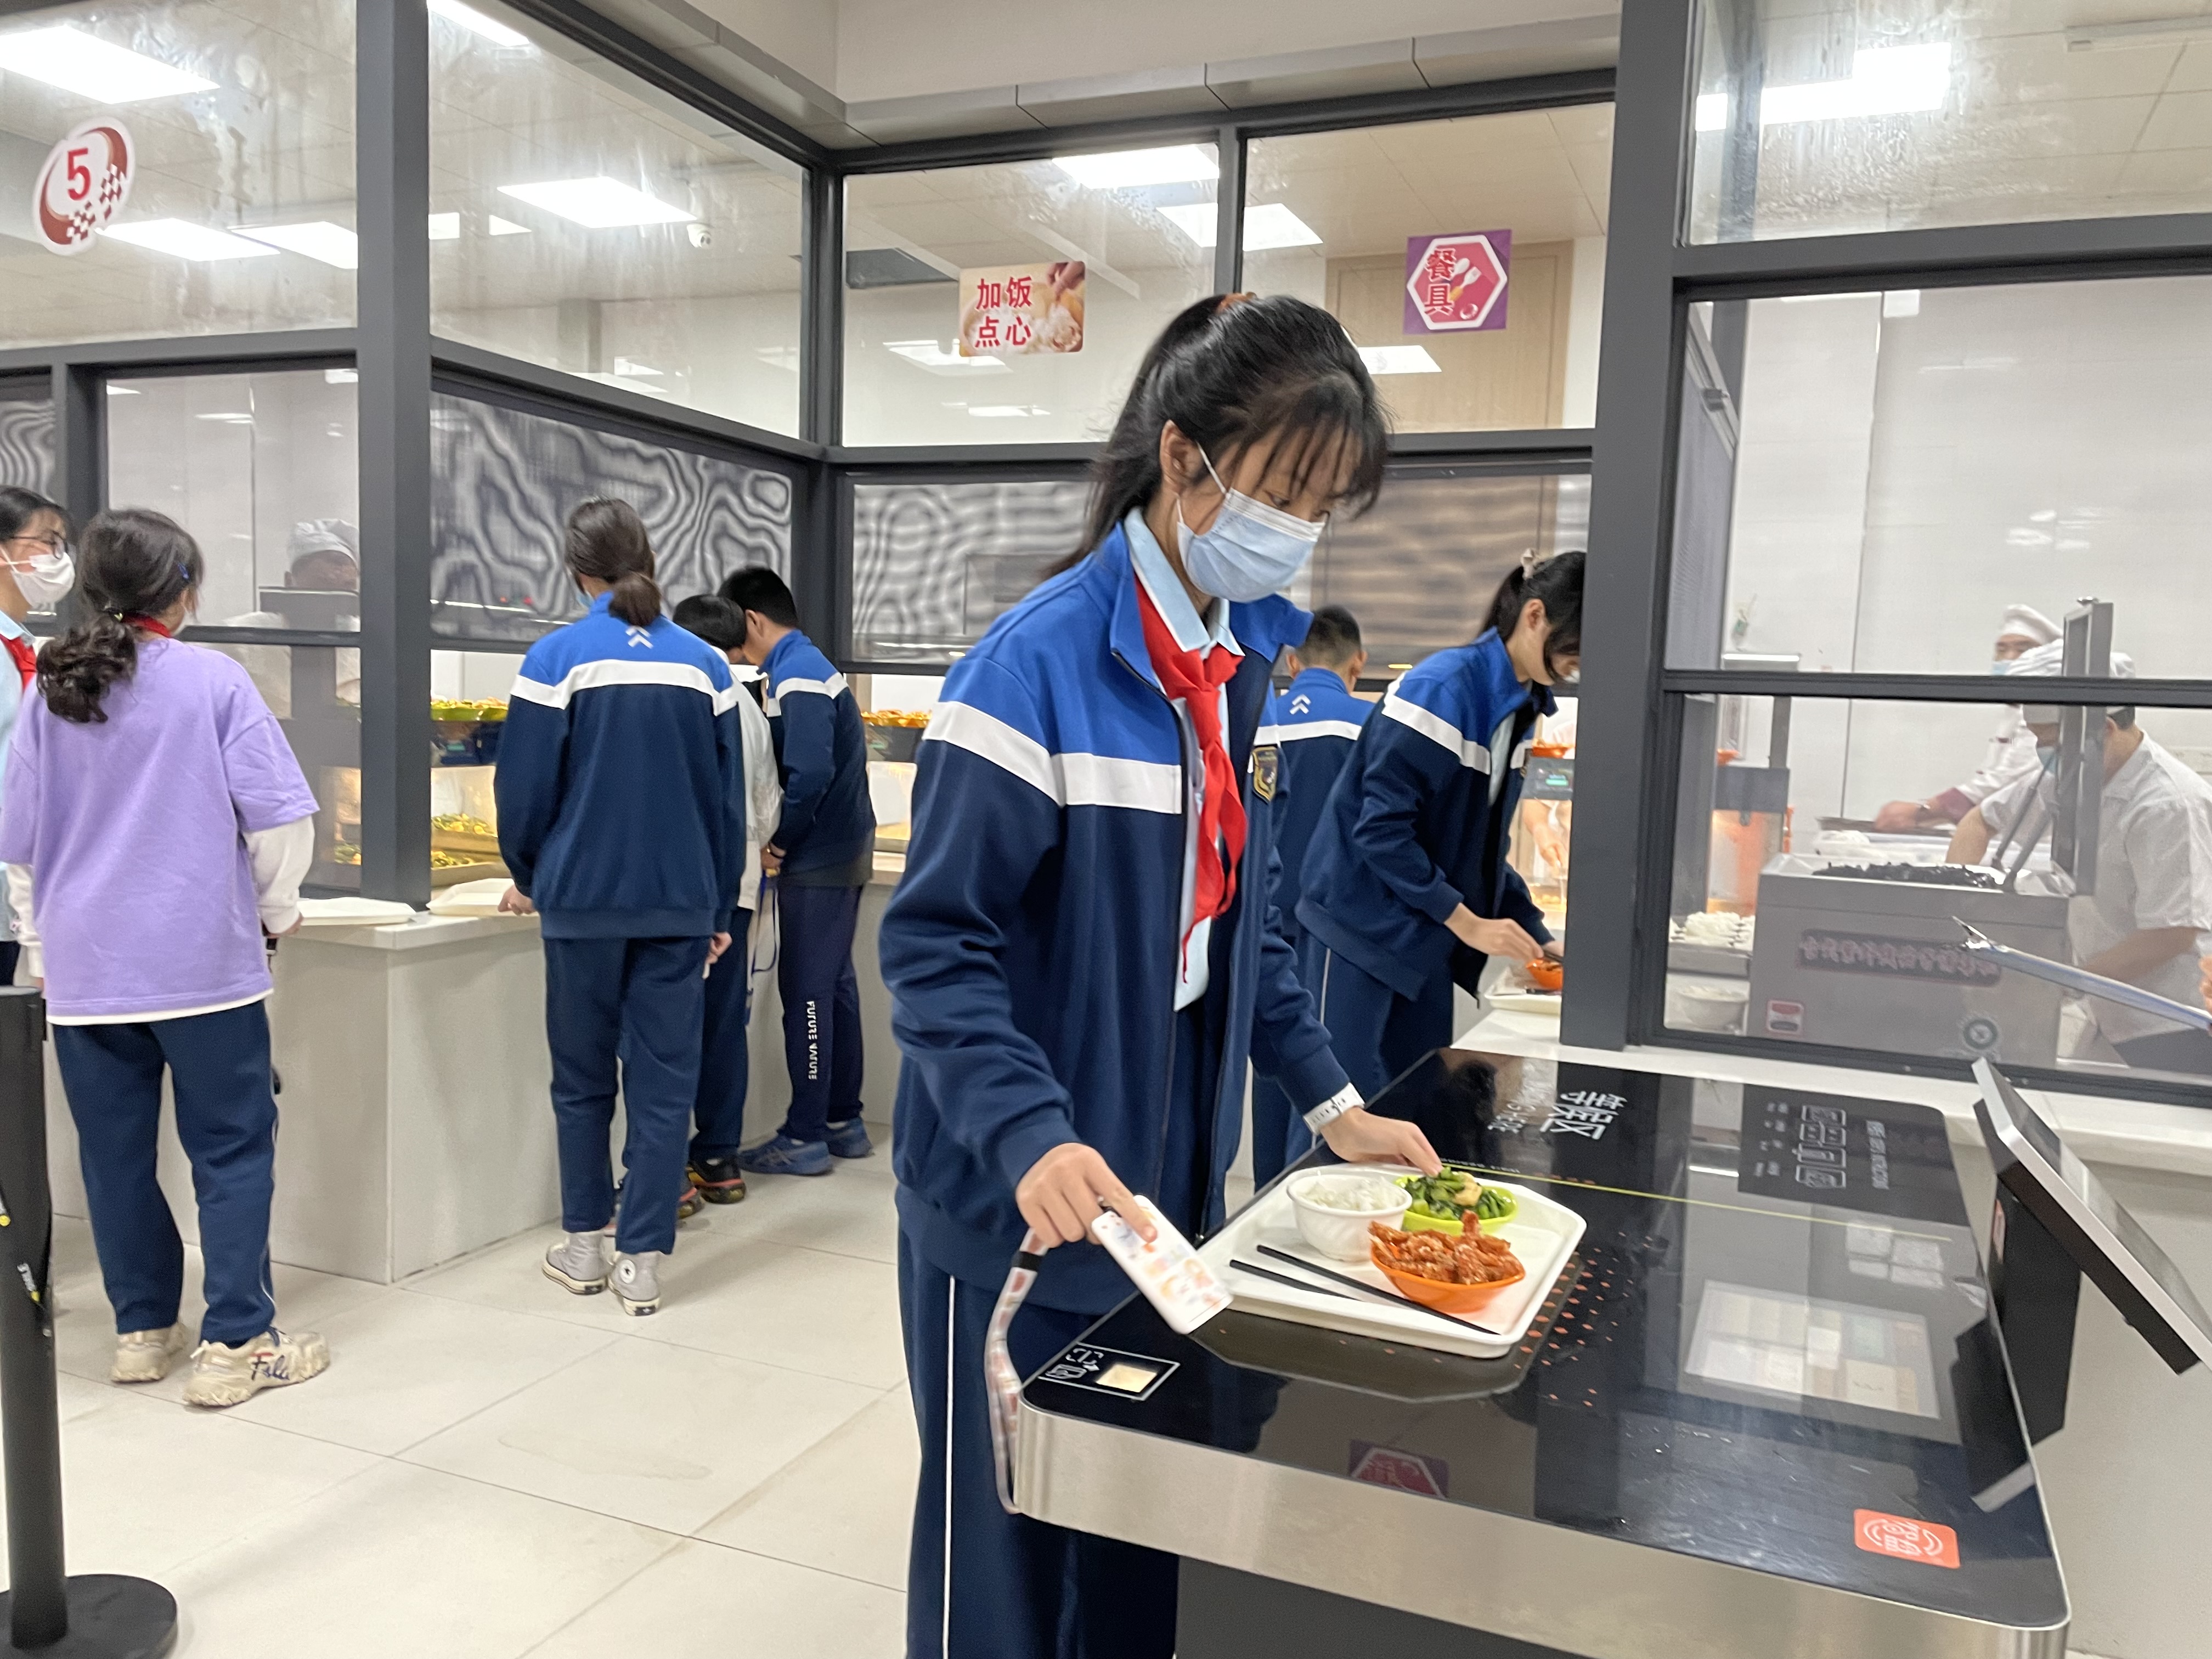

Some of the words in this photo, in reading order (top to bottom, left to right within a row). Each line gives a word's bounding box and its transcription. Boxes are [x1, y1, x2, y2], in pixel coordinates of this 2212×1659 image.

[67, 147, 91, 201] 5
[976, 276, 1032, 310] 加饭
[1424, 248, 1457, 316] 餐具
[975, 316, 1031, 348] 点心
[1540, 1091, 1628, 1140] 等候区
